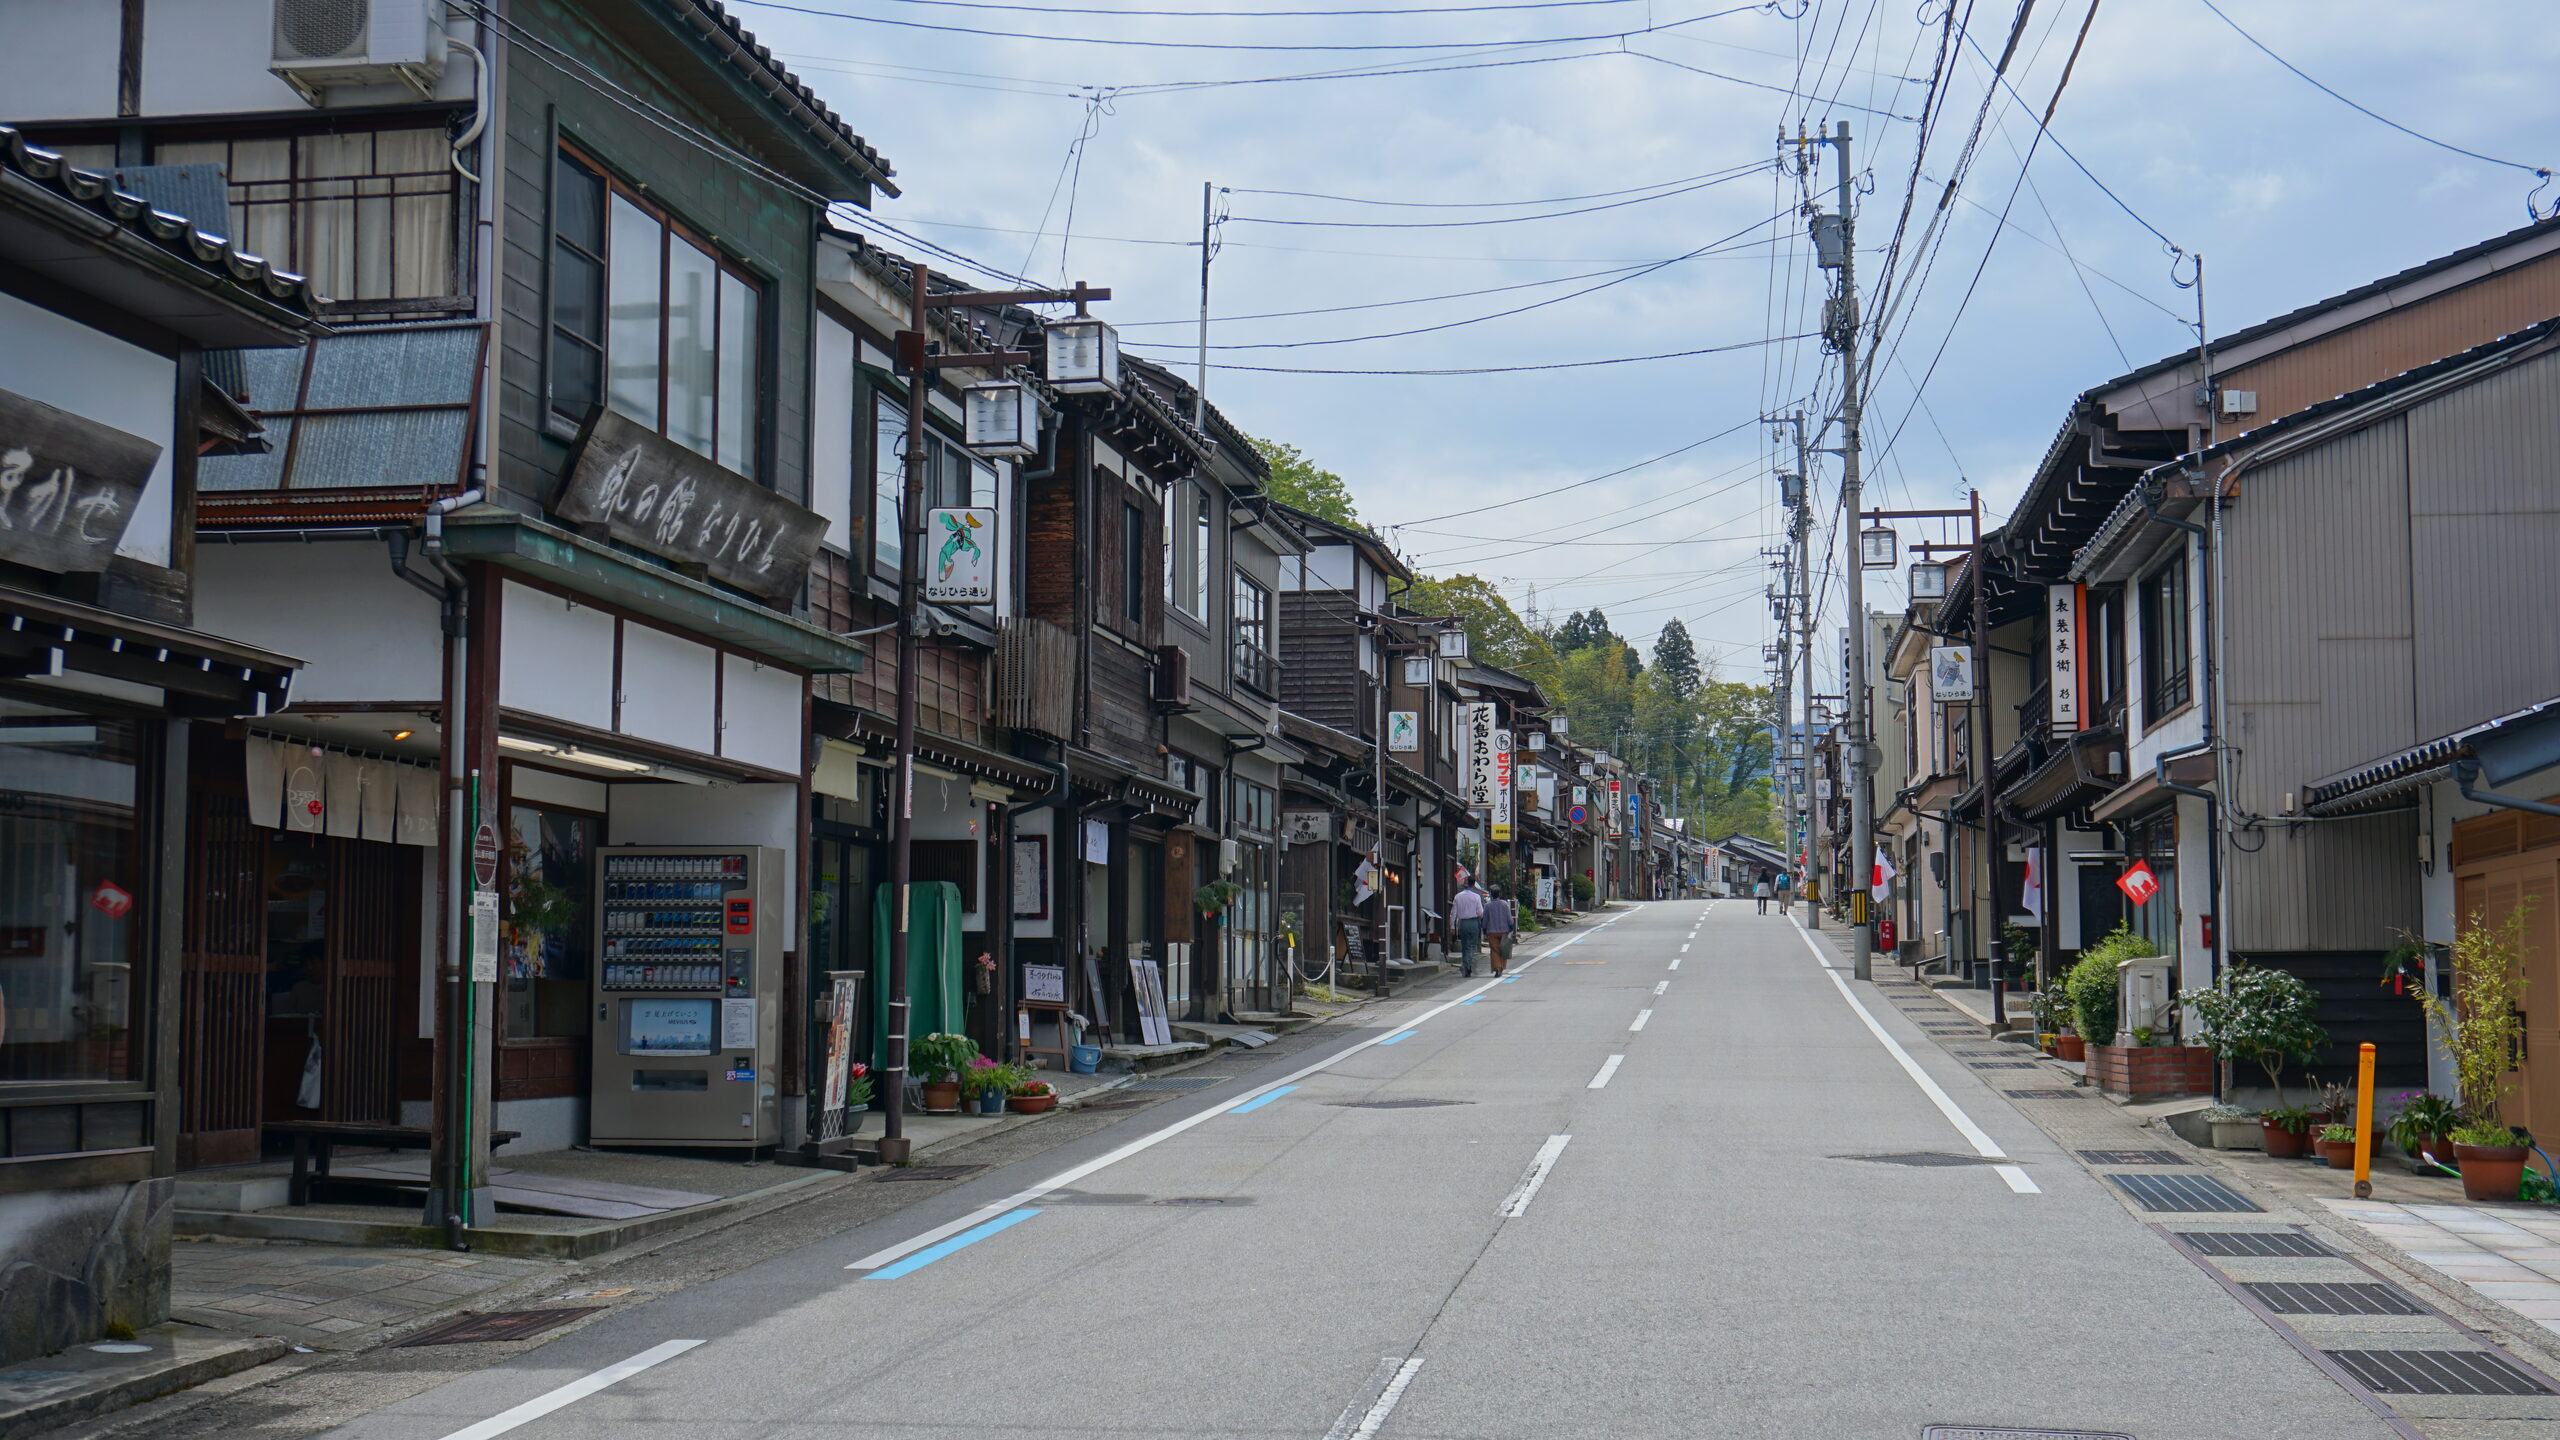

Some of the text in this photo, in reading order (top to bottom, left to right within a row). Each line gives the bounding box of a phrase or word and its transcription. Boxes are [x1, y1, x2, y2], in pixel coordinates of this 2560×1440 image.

[928, 586, 989, 597] なりひら通り
[1472, 705, 1490, 804] 花島おわら堂
[1499, 788, 1509, 823] ボールペン
